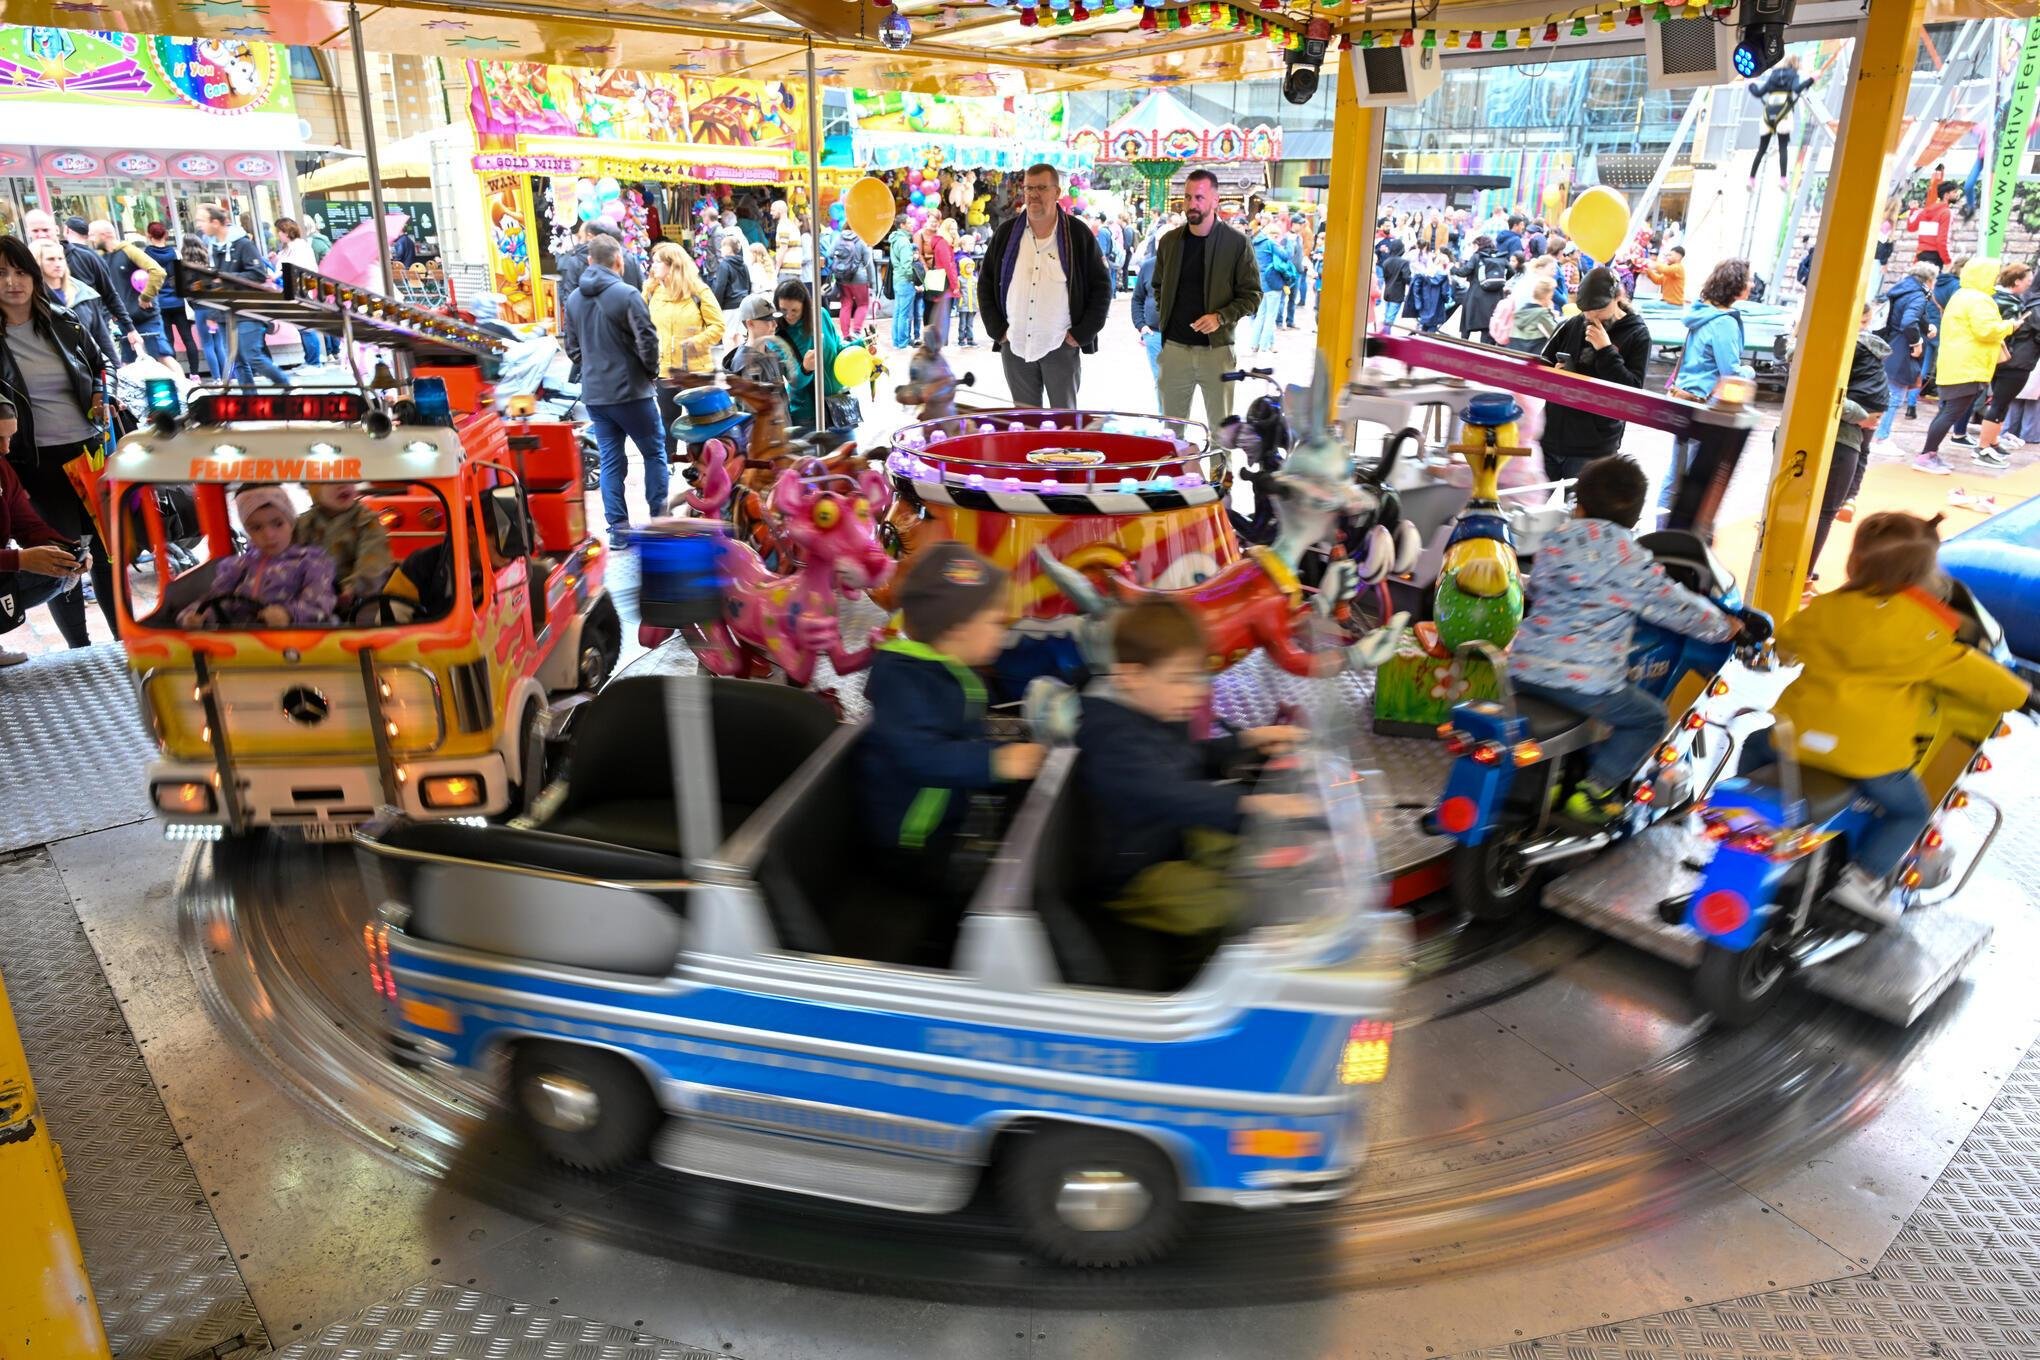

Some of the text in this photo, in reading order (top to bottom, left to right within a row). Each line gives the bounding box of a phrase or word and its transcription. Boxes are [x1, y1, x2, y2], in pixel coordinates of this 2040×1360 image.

[189, 61, 214, 77] You
[204, 83, 228, 98] Can
[496, 157, 573, 170] GOLD MINE
[189, 458, 362, 481] FEUERWEHR
